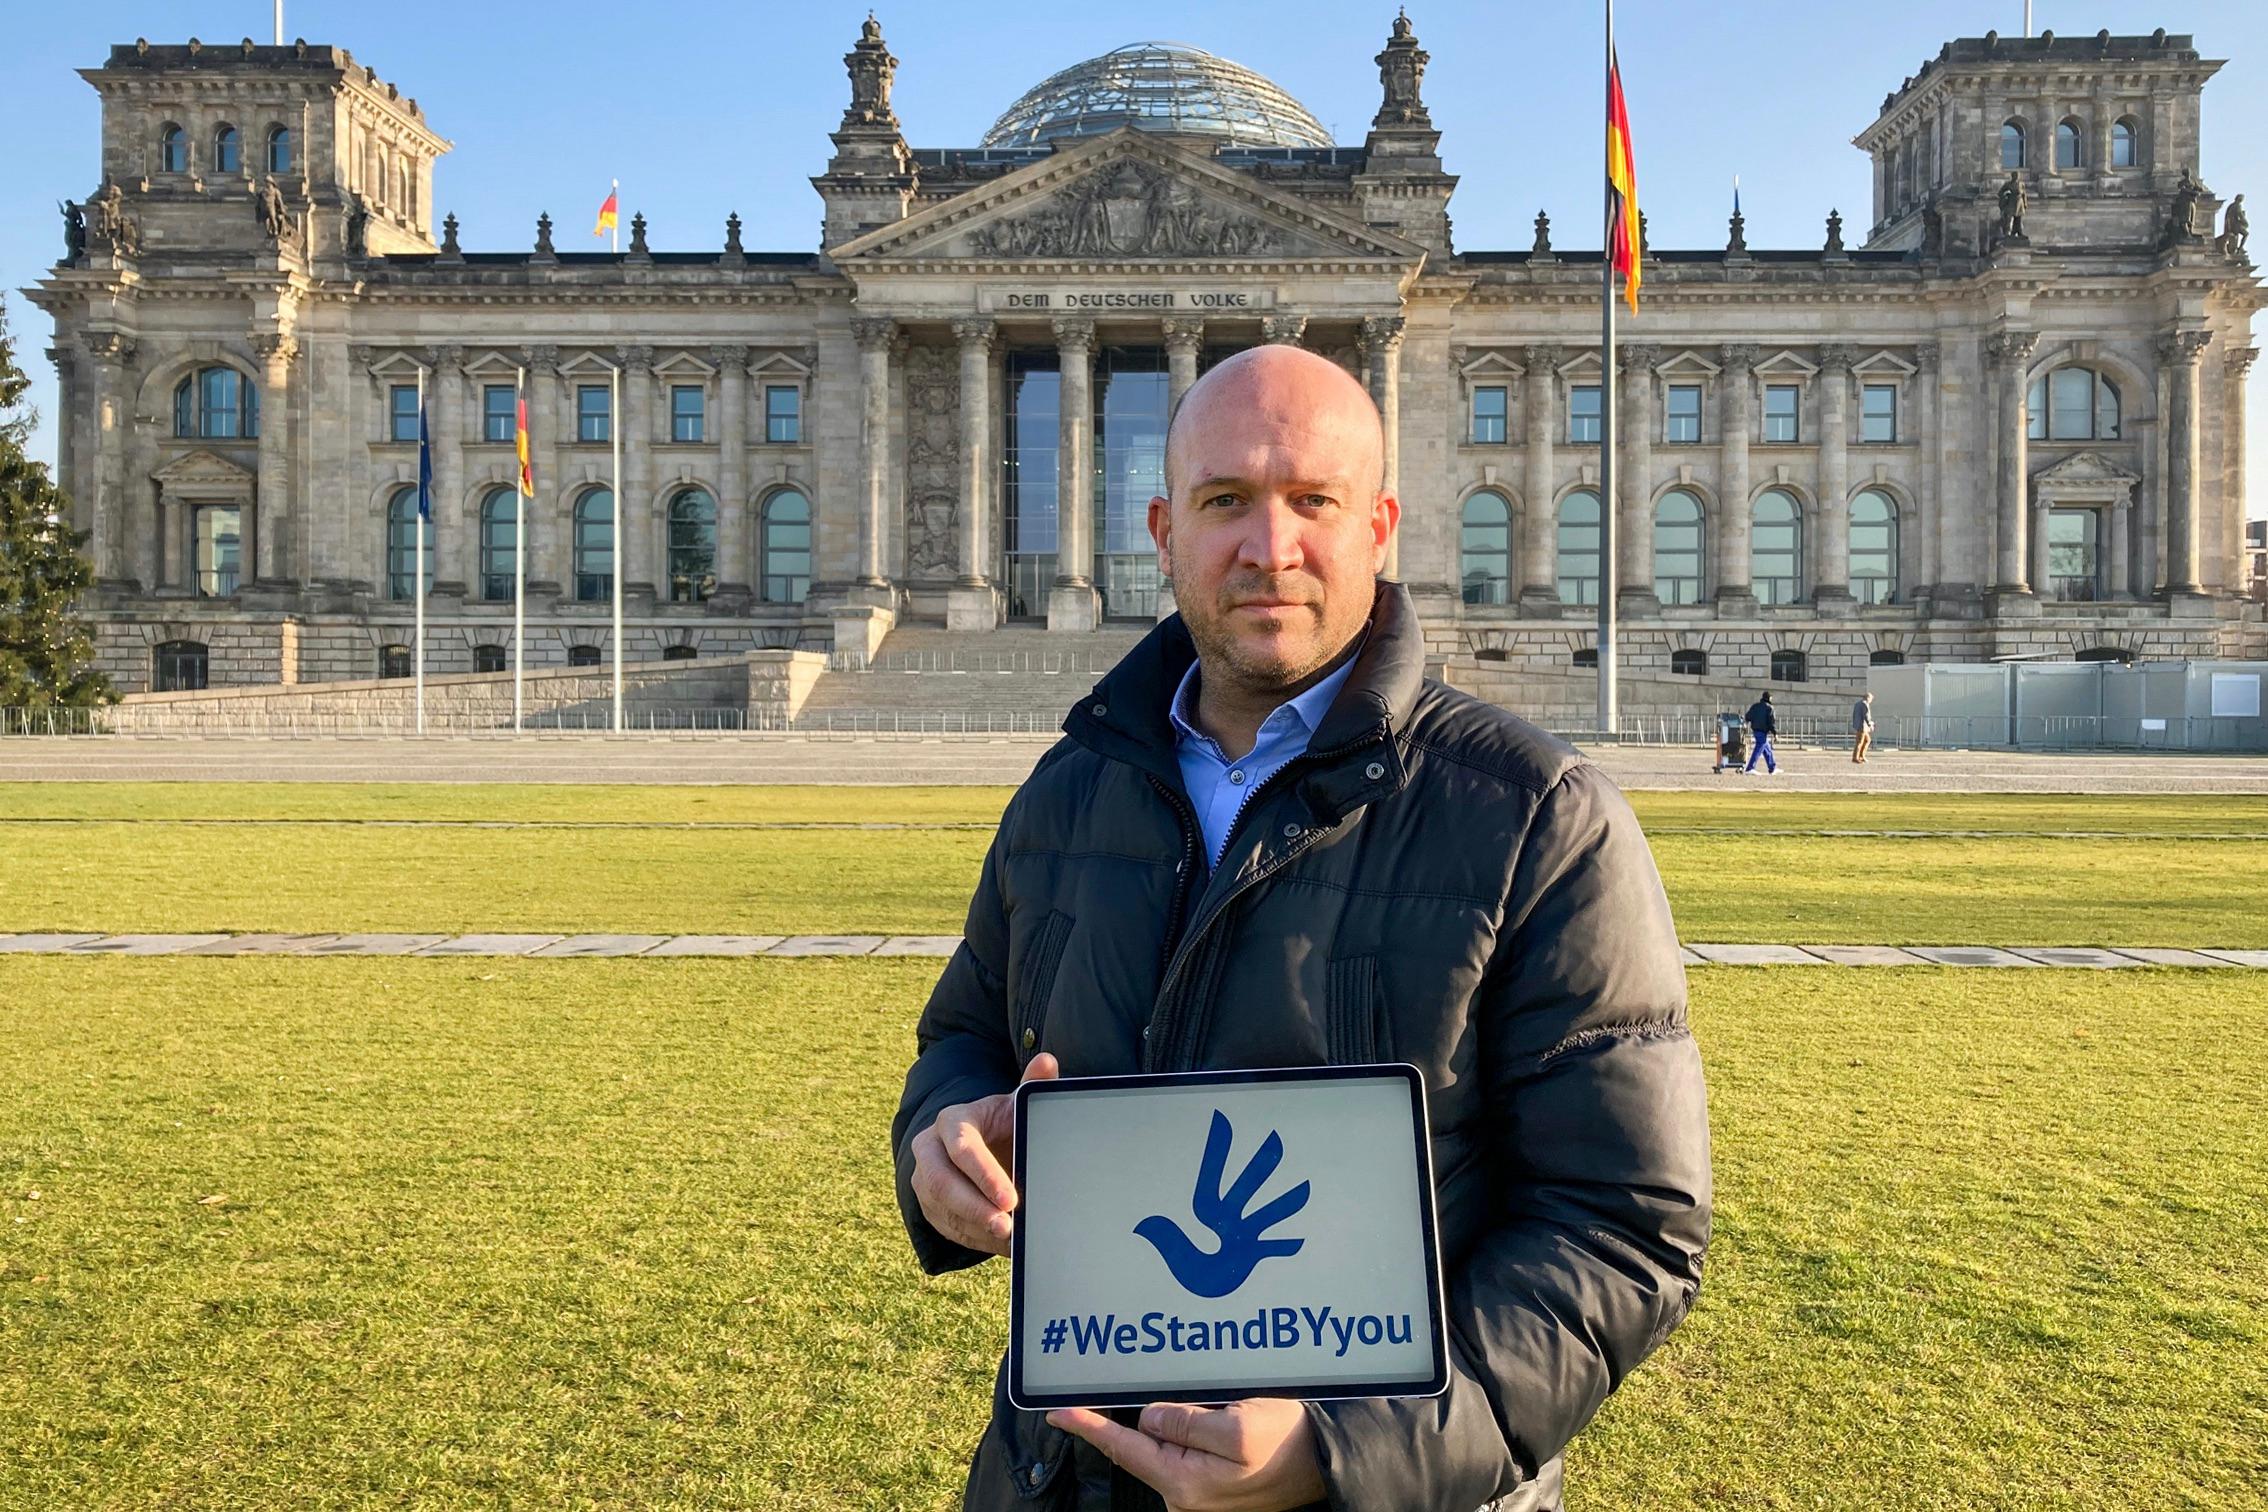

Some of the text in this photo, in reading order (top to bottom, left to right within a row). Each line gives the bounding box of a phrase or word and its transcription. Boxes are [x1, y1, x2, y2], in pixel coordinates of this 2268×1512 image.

[1008, 293, 1248, 307] DEM DEUTSCHEN VOLKE
[1040, 1306, 1413, 1357] #WeStandBYyou
